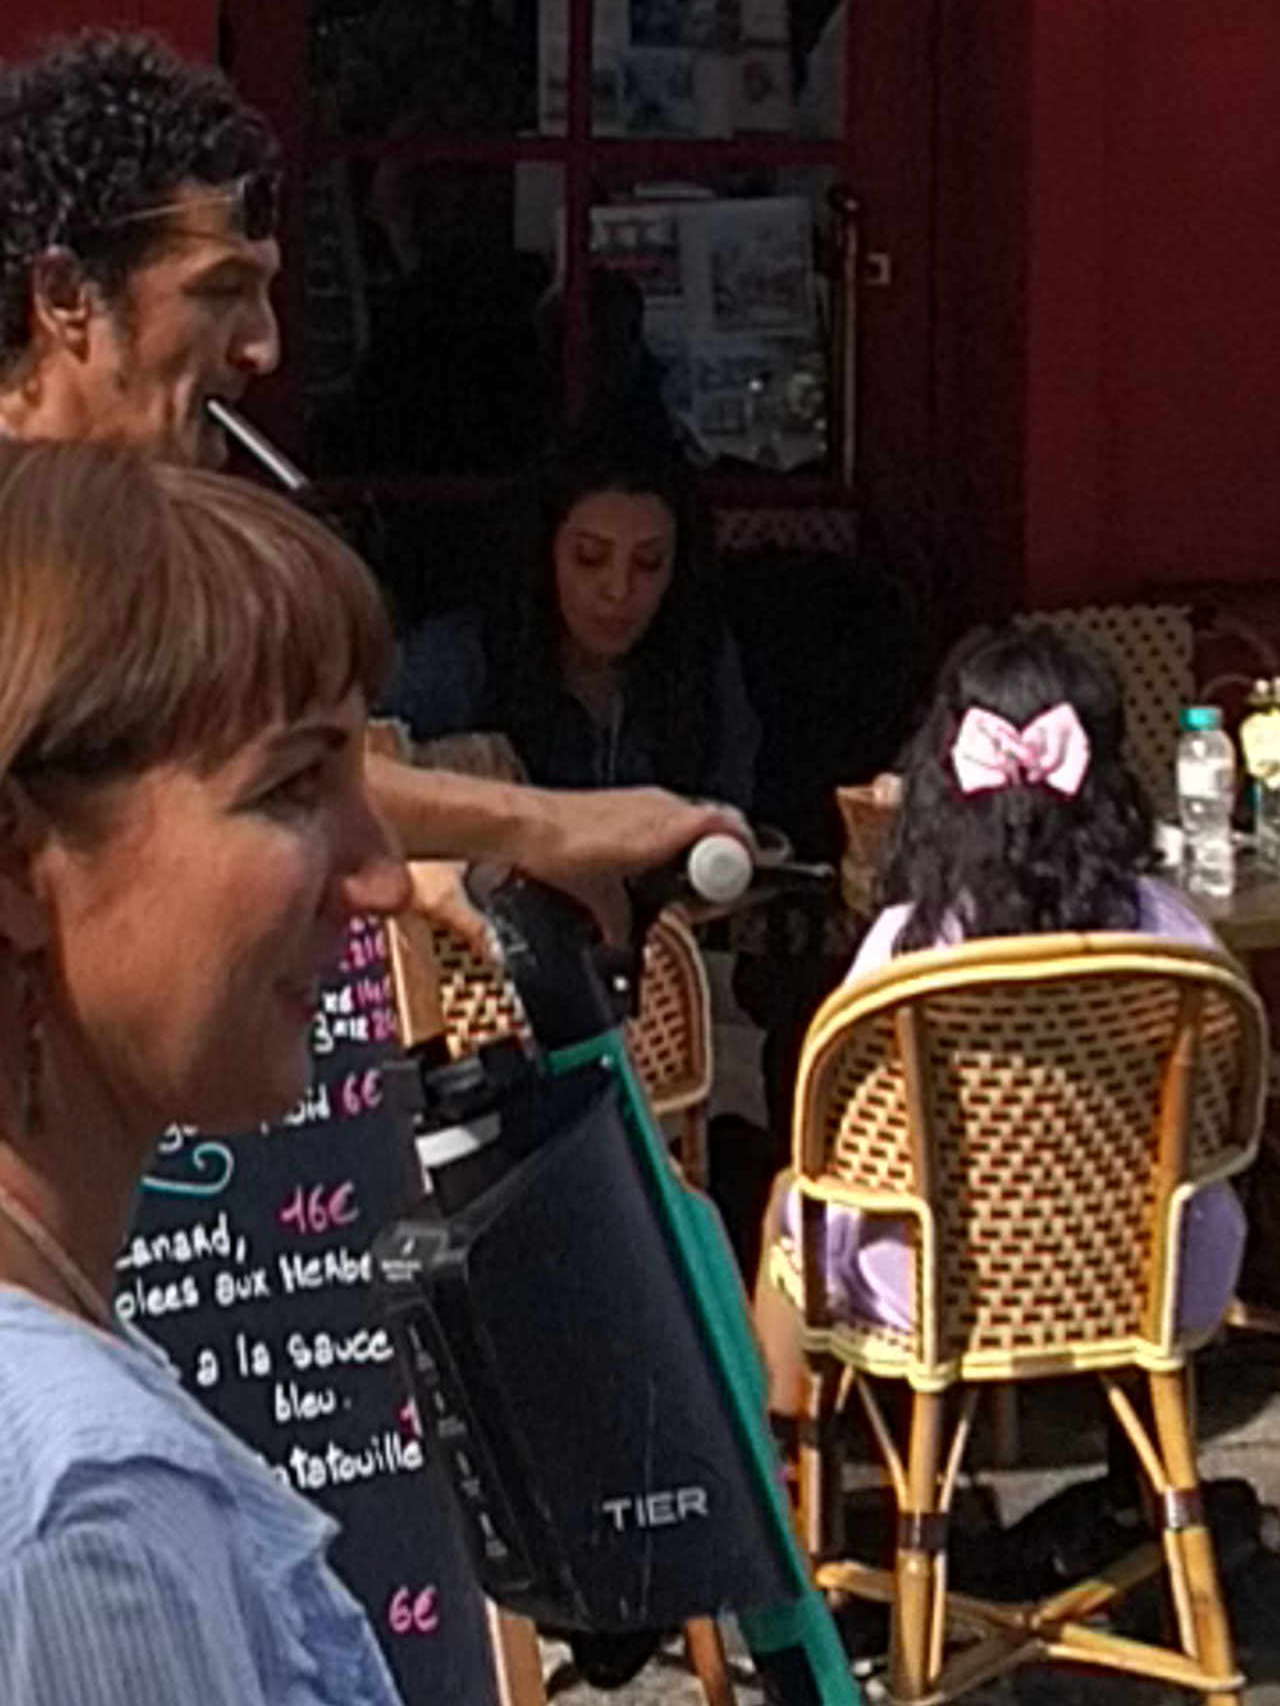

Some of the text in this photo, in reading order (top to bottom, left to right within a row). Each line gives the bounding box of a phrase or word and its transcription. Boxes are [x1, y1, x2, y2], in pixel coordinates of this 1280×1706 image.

[280, 1180, 361, 1235] 16€
[215, 1271, 271, 1307] aux
[236, 1333, 271, 1378] la
[286, 1328, 394, 1371] sauce
[602, 1487, 709, 1532] TIER
[387, 1587, 439, 1634] 6€
